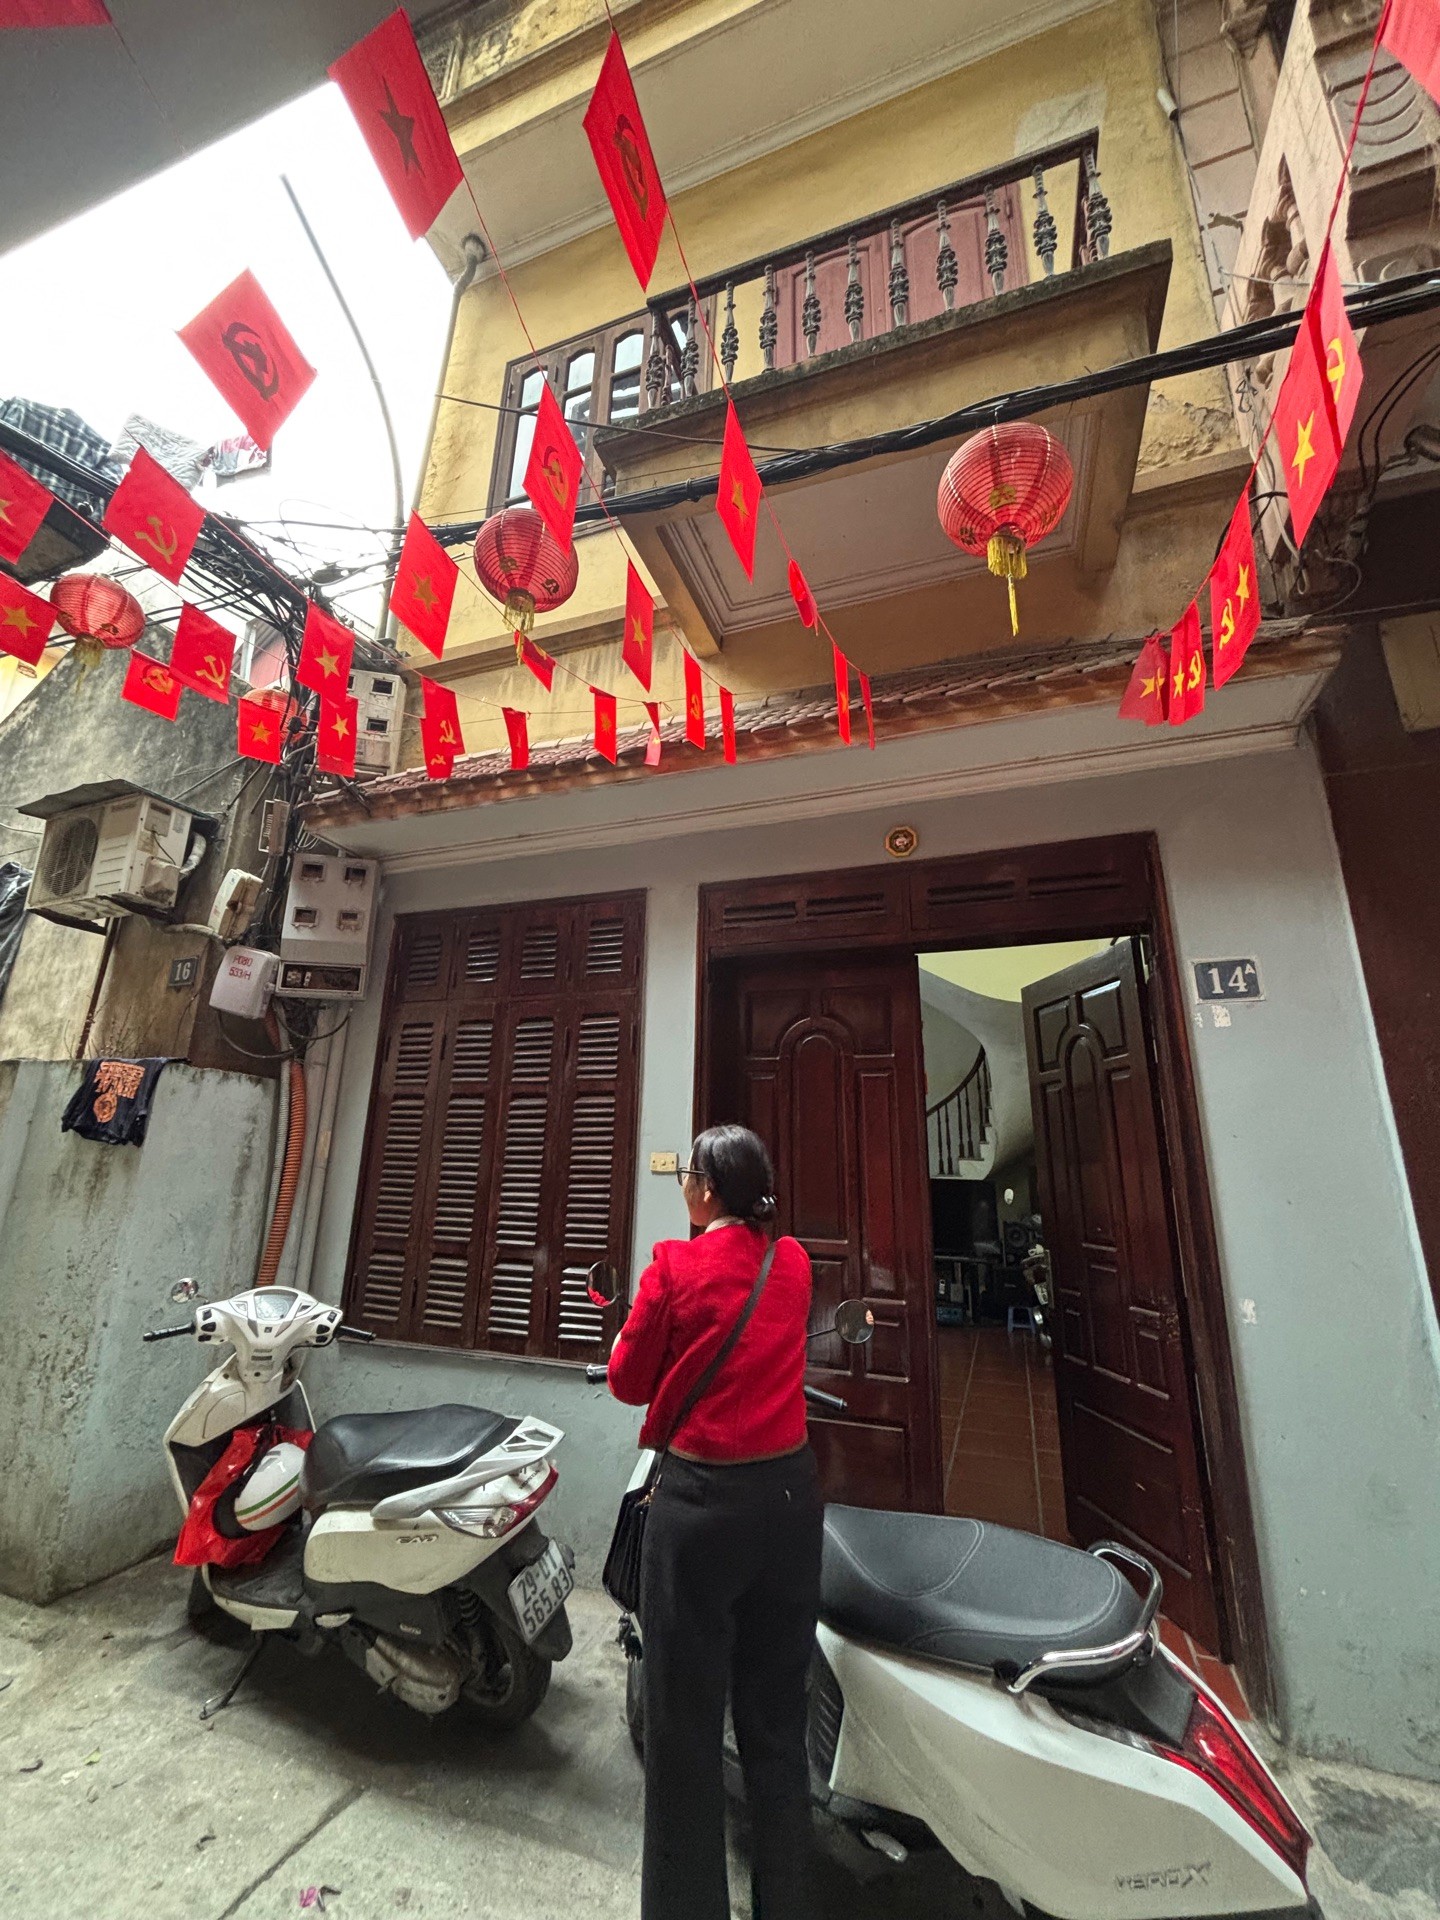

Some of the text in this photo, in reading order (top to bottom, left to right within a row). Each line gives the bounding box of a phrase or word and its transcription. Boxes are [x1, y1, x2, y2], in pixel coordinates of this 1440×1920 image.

[174, 962, 191, 981] 16
[1208, 963, 1256, 994] 14A
[522, 1567, 570, 1634] 565.83
